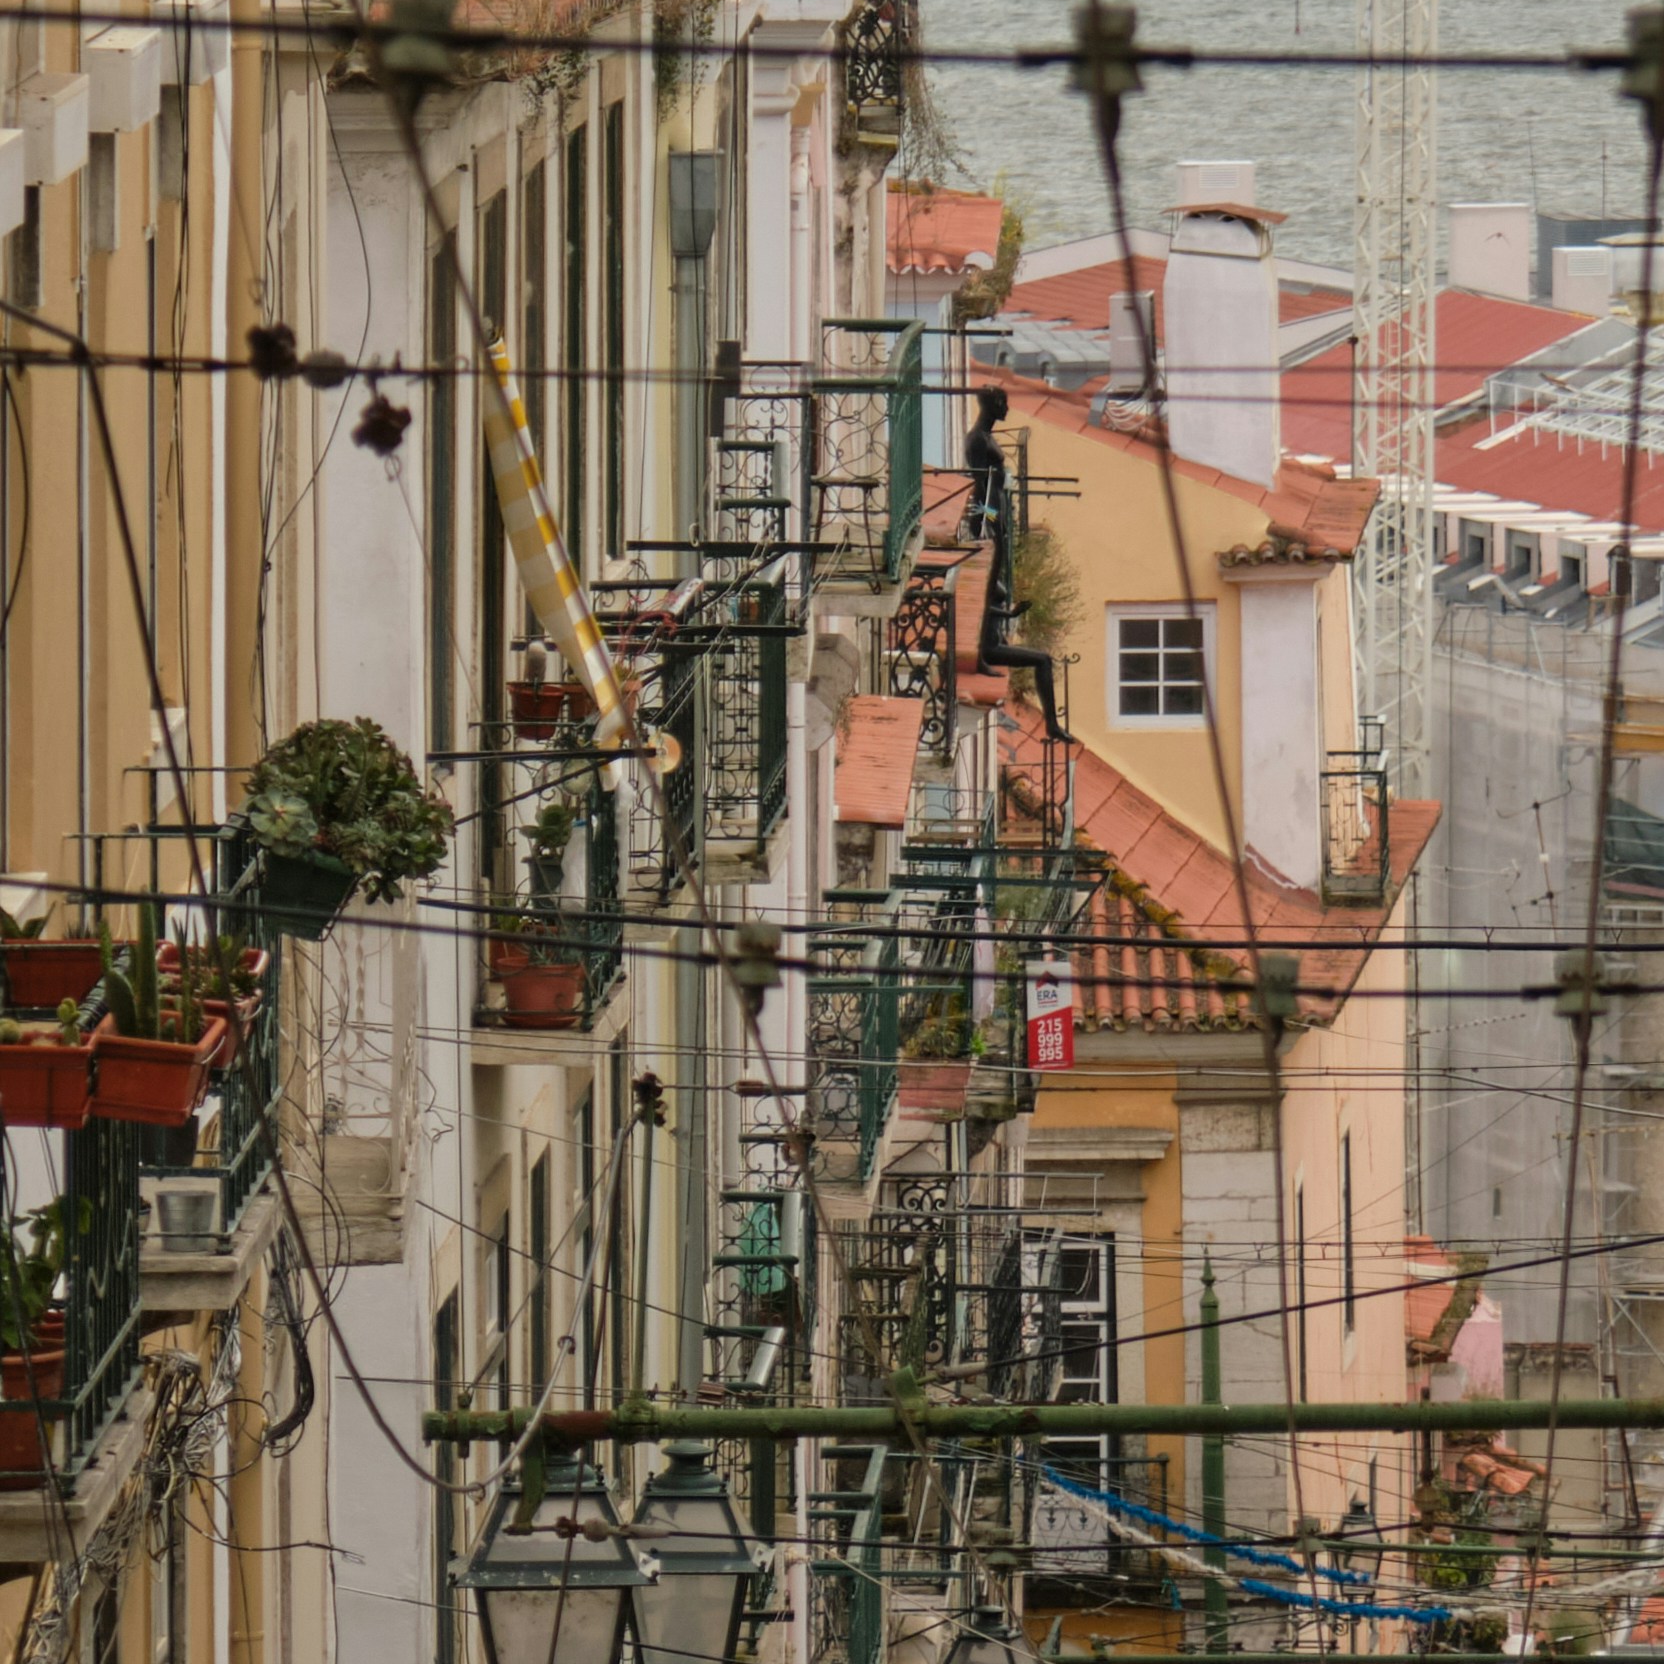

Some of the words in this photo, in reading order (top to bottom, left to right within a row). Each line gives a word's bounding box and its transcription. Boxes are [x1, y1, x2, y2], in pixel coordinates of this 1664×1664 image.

[1037, 989, 1058, 1000] ERA
[1037, 1019, 1062, 1033] 215
[1038, 1033, 1063, 1047] 999
[1038, 1047, 1063, 1061] 995
